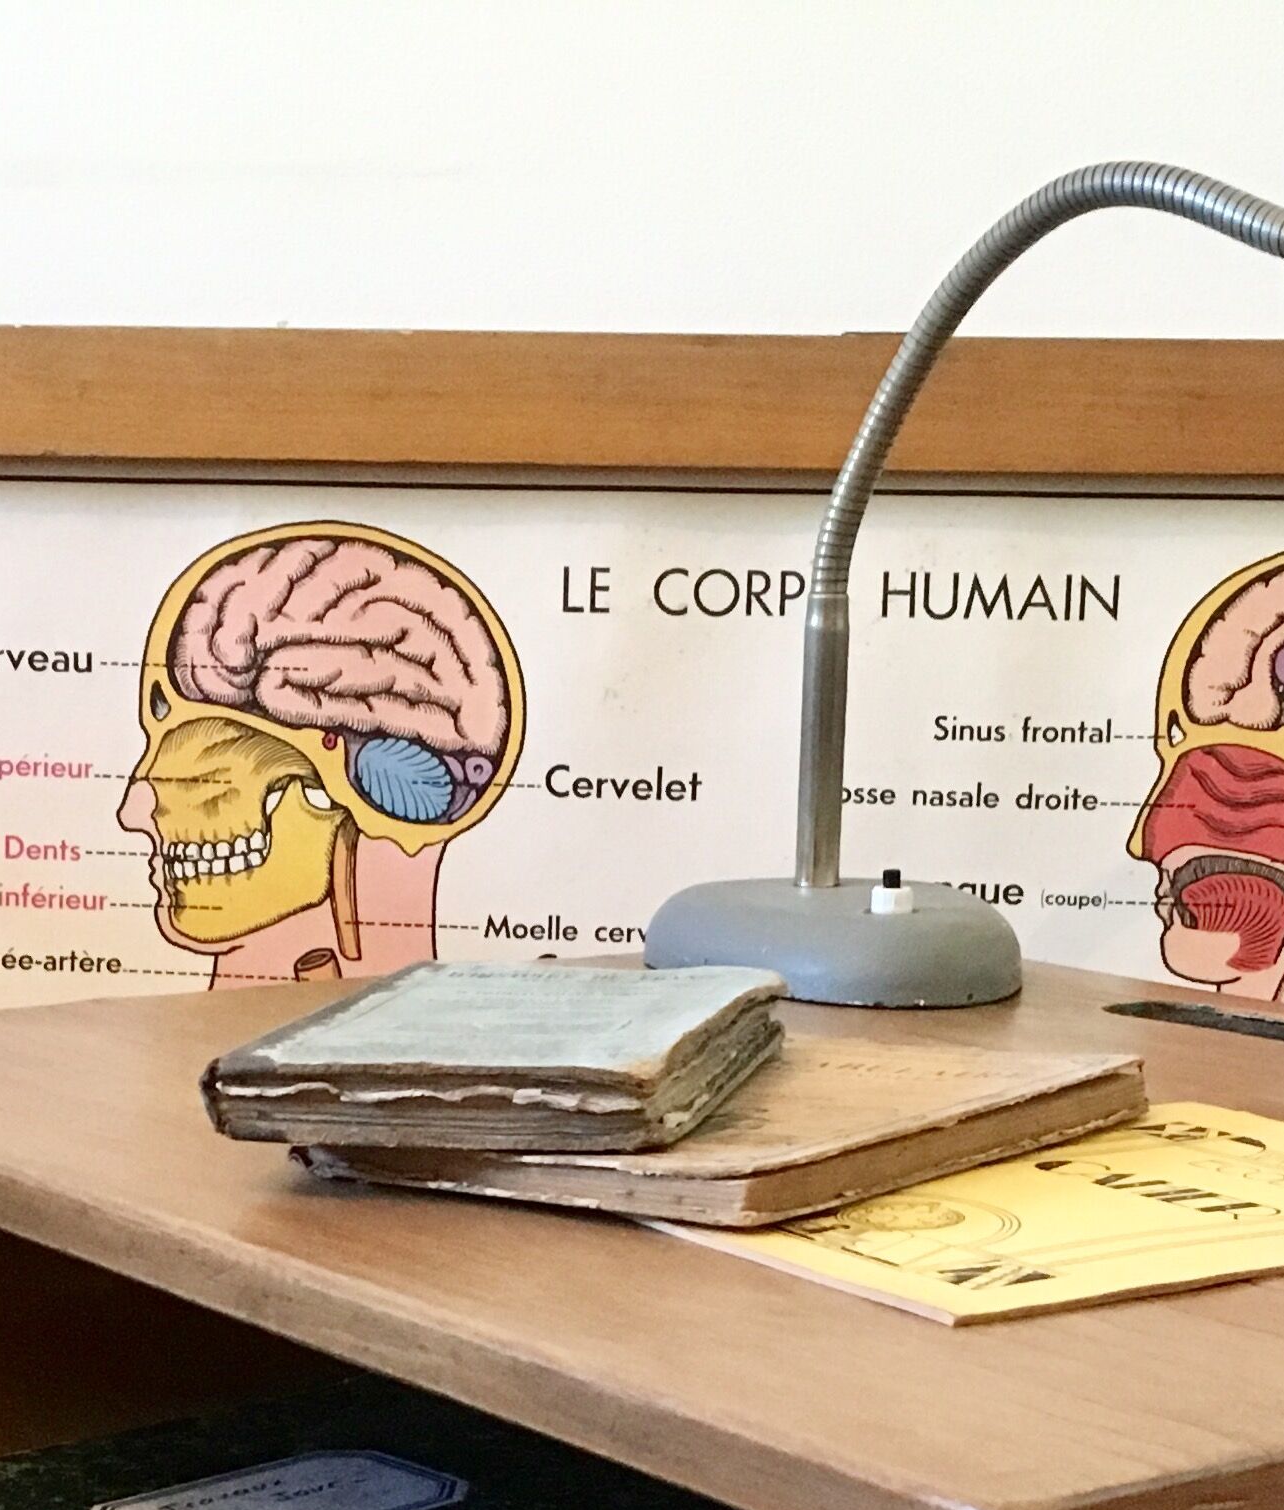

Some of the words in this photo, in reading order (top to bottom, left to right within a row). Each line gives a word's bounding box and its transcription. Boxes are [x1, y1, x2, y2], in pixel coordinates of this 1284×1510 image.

[562, 566, 611, 614] LE
[653, 567, 805, 618] CORP
[881, 570, 1121, 622] HUMAIN
[933, 715, 1006, 743] Sinus
[1021, 715, 1112, 744] frontal
[545, 764, 703, 802] Cervelet
[842, 787, 897, 805] osse
[912, 781, 1000, 809] nasale
[1015, 782, 1098, 811] droite
[4, 834, 81, 862] Dents
[1041, 890, 1107, 910] (coupe)
[483, 914, 579, 942] Moelle
